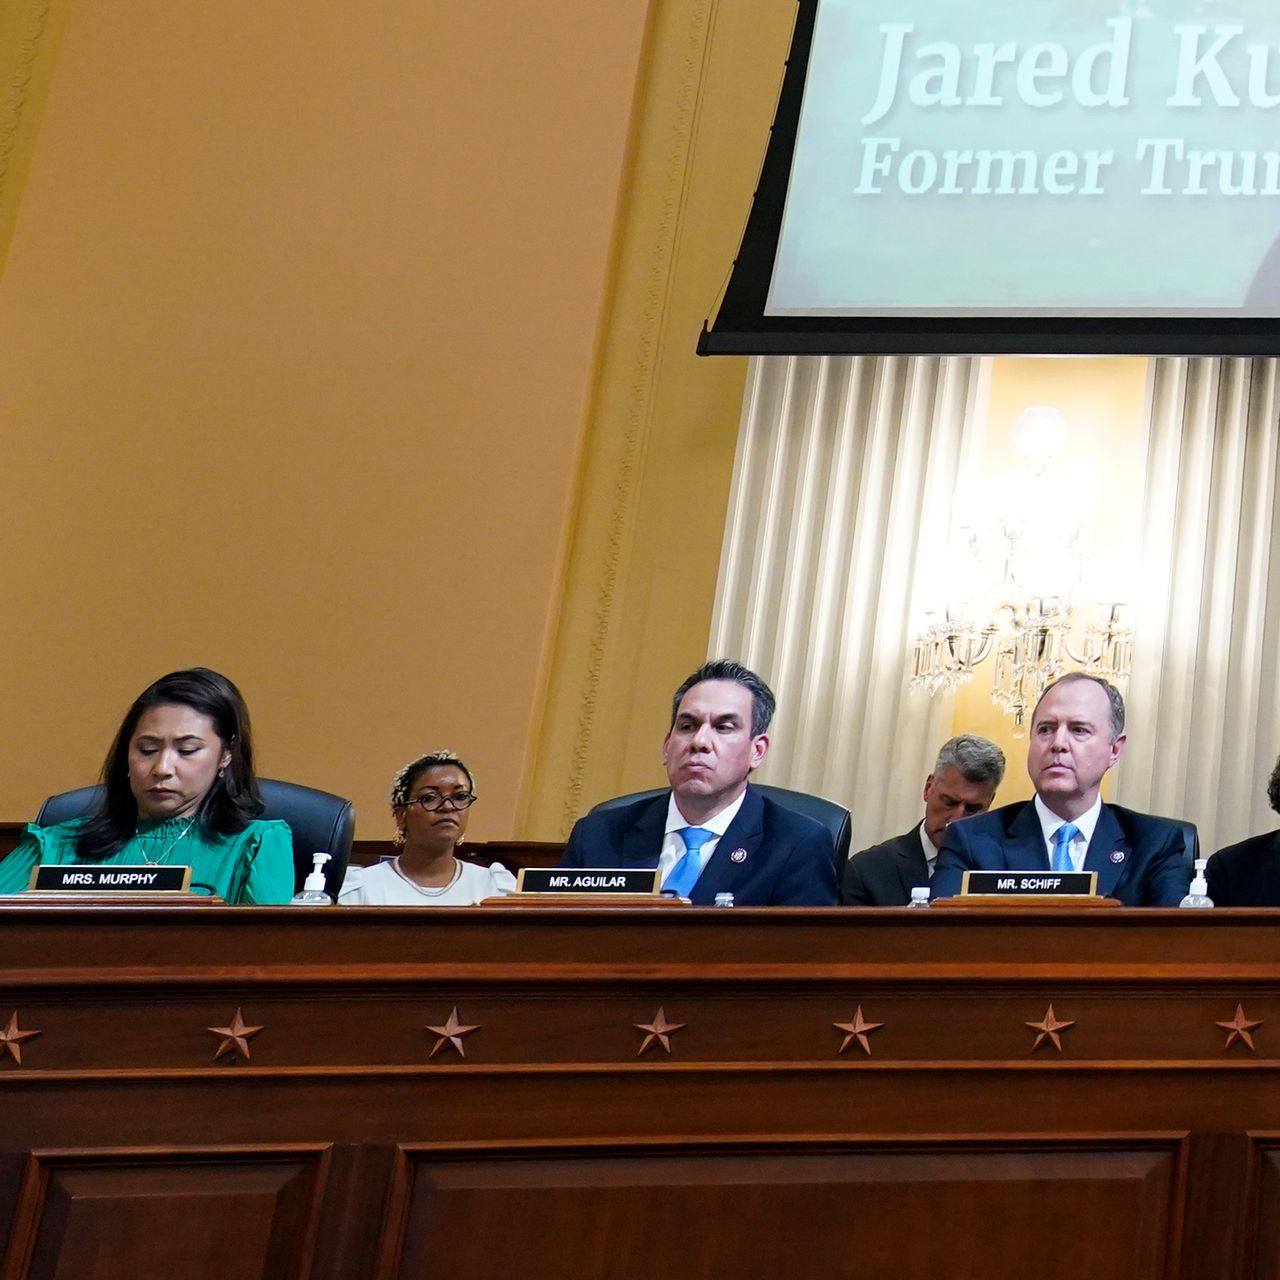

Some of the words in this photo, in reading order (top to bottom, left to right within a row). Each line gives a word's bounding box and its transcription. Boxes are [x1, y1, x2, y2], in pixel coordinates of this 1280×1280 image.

[861, 18, 1132, 125] Jared
[854, 137, 1114, 195] Former
[62, 873, 96, 885] MRS.
[98, 873, 158, 884] MURPHY
[549, 876, 571, 887] MR.
[573, 876, 626, 887] AGUILAR
[997, 878, 1018, 889] MR.
[1020, 878, 1061, 889] SCHIFF
